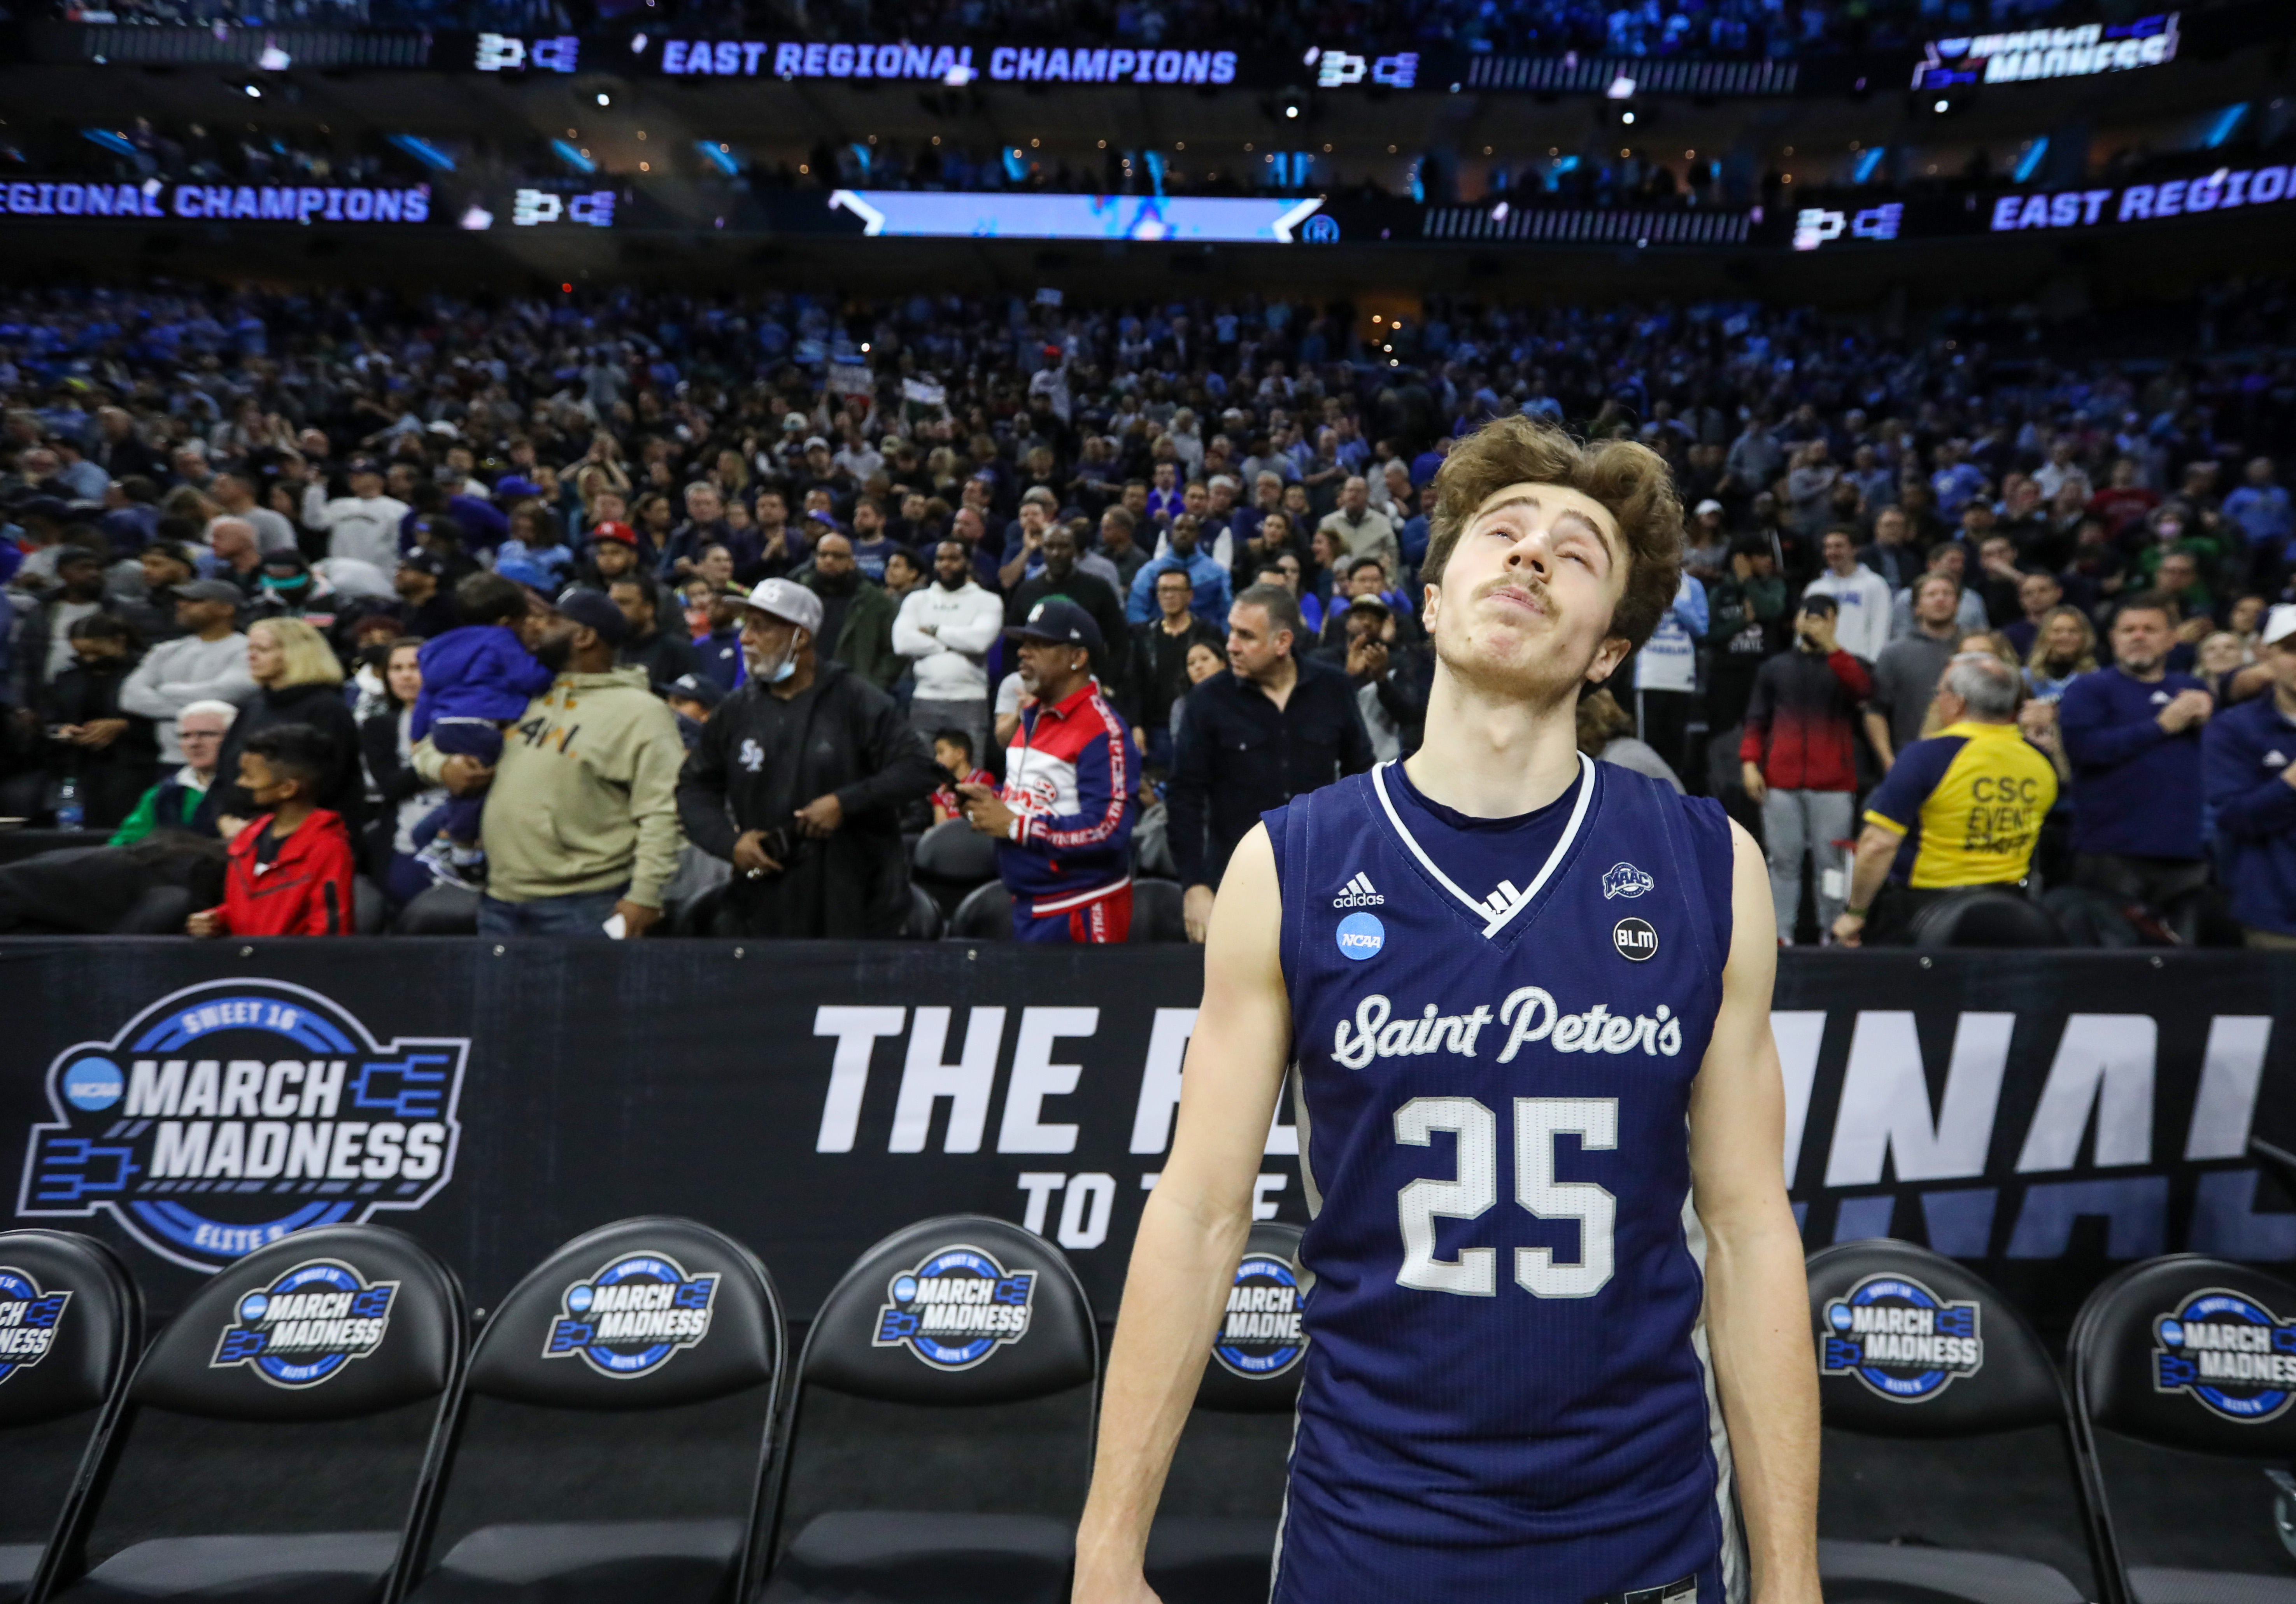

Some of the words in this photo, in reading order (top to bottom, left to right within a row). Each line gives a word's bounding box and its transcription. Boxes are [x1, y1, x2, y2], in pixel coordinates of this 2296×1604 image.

[662, 40, 767, 75] EAST
[775, 41, 978, 80] REGIONAL
[990, 47, 1237, 84] CHAMPIONS
[0, 181, 165, 217] GIONAL
[175, 186, 429, 222] CHAMPIONS
[1991, 189, 2111, 231] EAST
[2119, 165, 2296, 222] REGIO
[1972, 776, 2037, 803] CSC
[1603, 870, 1653, 898] MAAC
[1333, 893, 1385, 908] adidas
[1342, 933, 1381, 948] NCAA
[1617, 929, 1653, 948] BLM
[181, 1002, 263, 1034] SWEET
[266, 1004, 297, 1030] 16
[1331, 994, 1494, 1070] Saint
[1496, 986, 1682, 1063] Peter's
[124, 1060, 347, 1117] MARCH
[813, 1005, 1099, 1154] THE
[149, 1121, 444, 1179] MADNESS
[1017, 1172, 1116, 1249] TO
[1393, 1096, 1619, 1299] 25
[194, 1224, 262, 1251] ELITE
[590, 1284, 676, 1313] MARCH
[914, 1278, 995, 1304] MARCH
[263, 1292, 354, 1321] MARCH
[922, 1304, 1027, 1331] MADNESS
[1852, 1306, 1933, 1335] MARCH
[268, 1318, 383, 1348] MADNESS
[596, 1308, 708, 1338] MADNESS
[1226, 1312, 1302, 1339] MADNE
[2184, 1322, 2271, 1353] MARCH
[1865, 1333, 1977, 1364] MADNESS
[2199, 1350, 2296, 1383] MADNES
